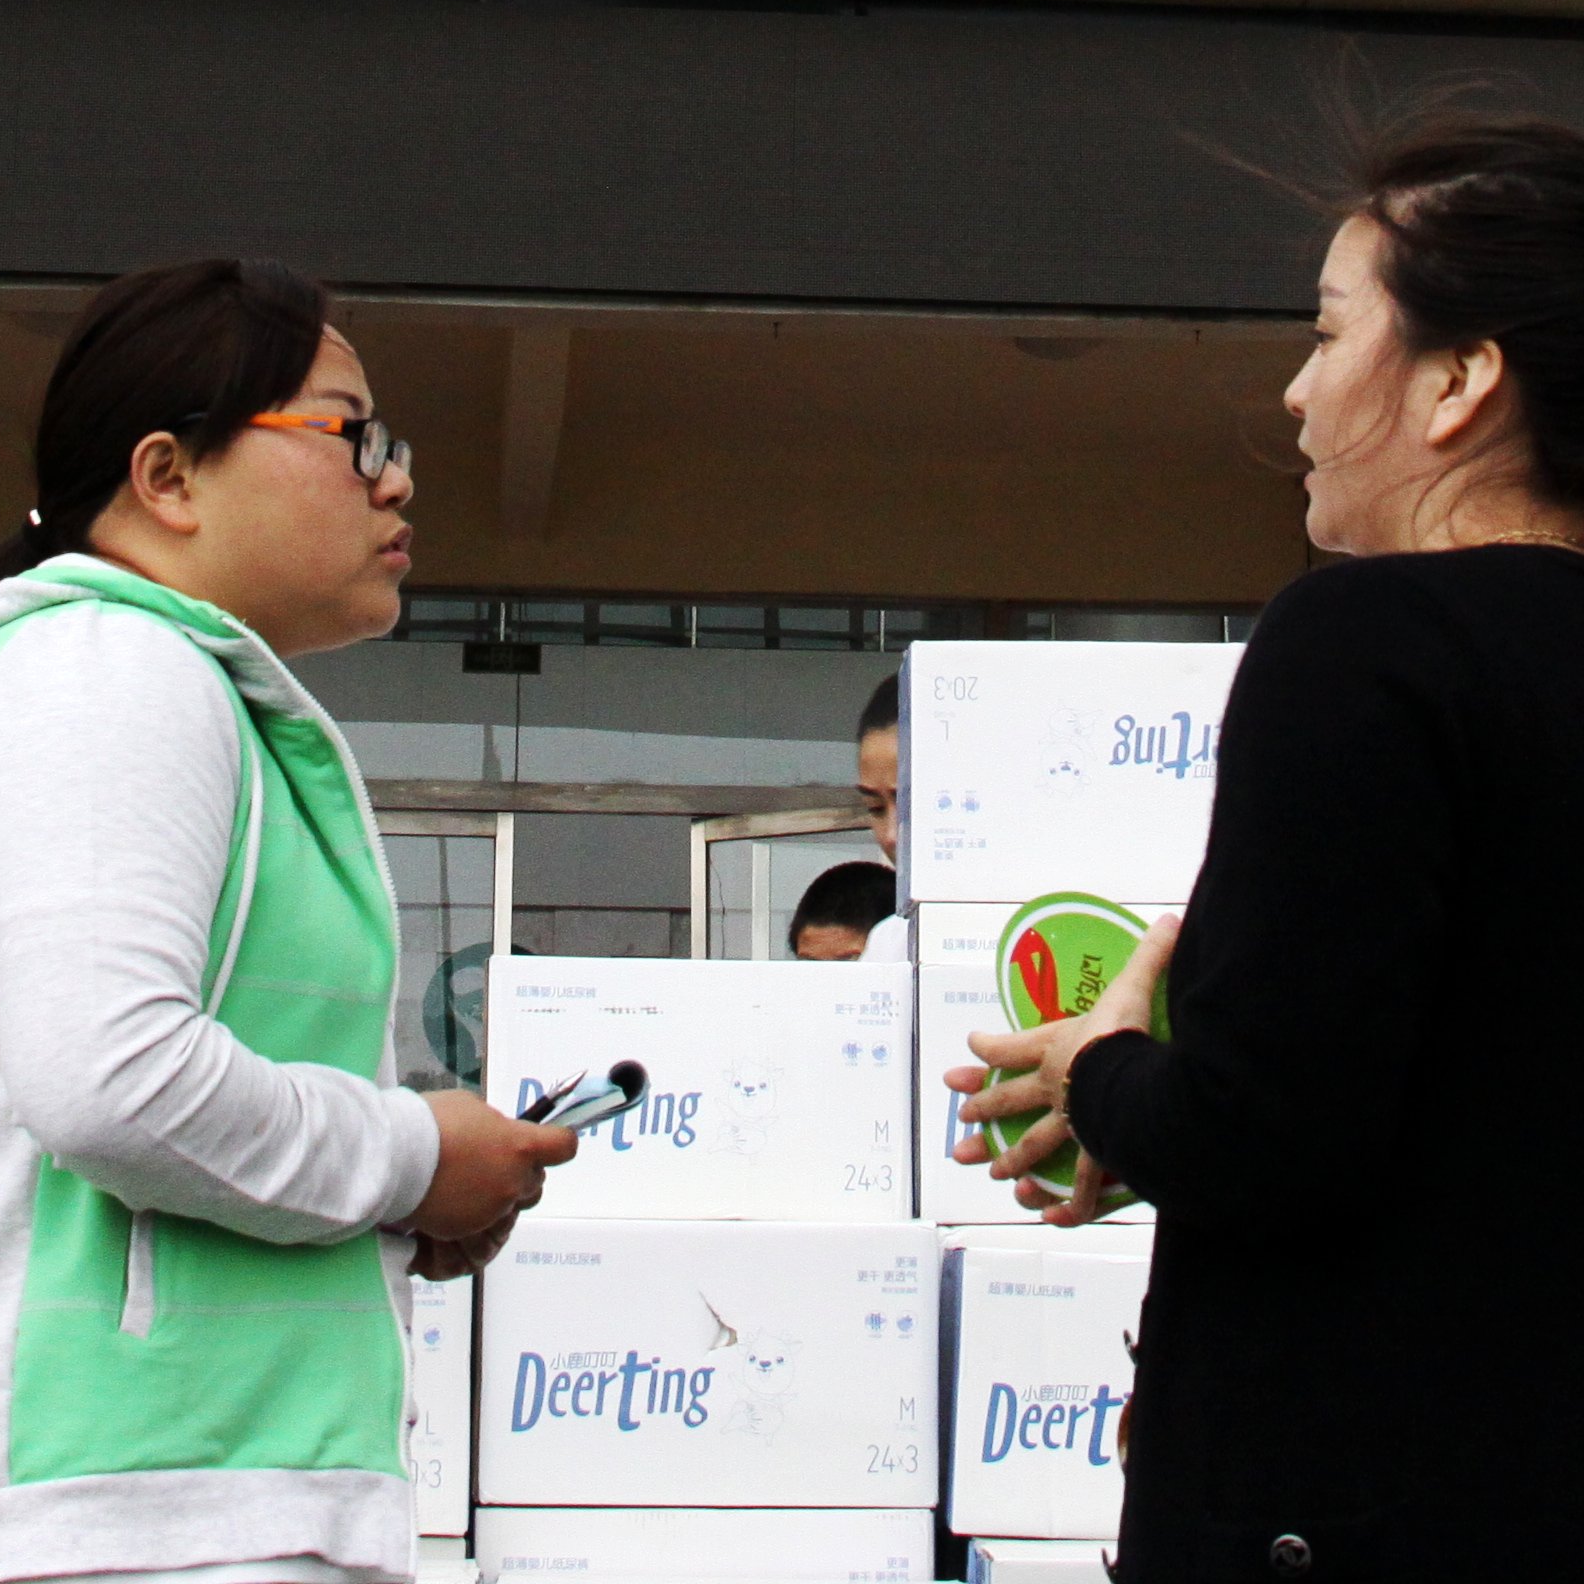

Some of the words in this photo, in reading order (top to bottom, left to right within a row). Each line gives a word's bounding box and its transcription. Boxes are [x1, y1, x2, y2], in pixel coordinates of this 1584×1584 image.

[873, 1120, 890, 1144] M
[549, 1350, 618, 1370] 小鹿叮叮
[511, 1350, 715, 1433] Deerting
[1021, 1383, 1090, 1402] 小鹿叮叮
[898, 1396, 916, 1421] M
[424, 1410, 437, 1435] L
[981, 1381, 1132, 1466] Deert
